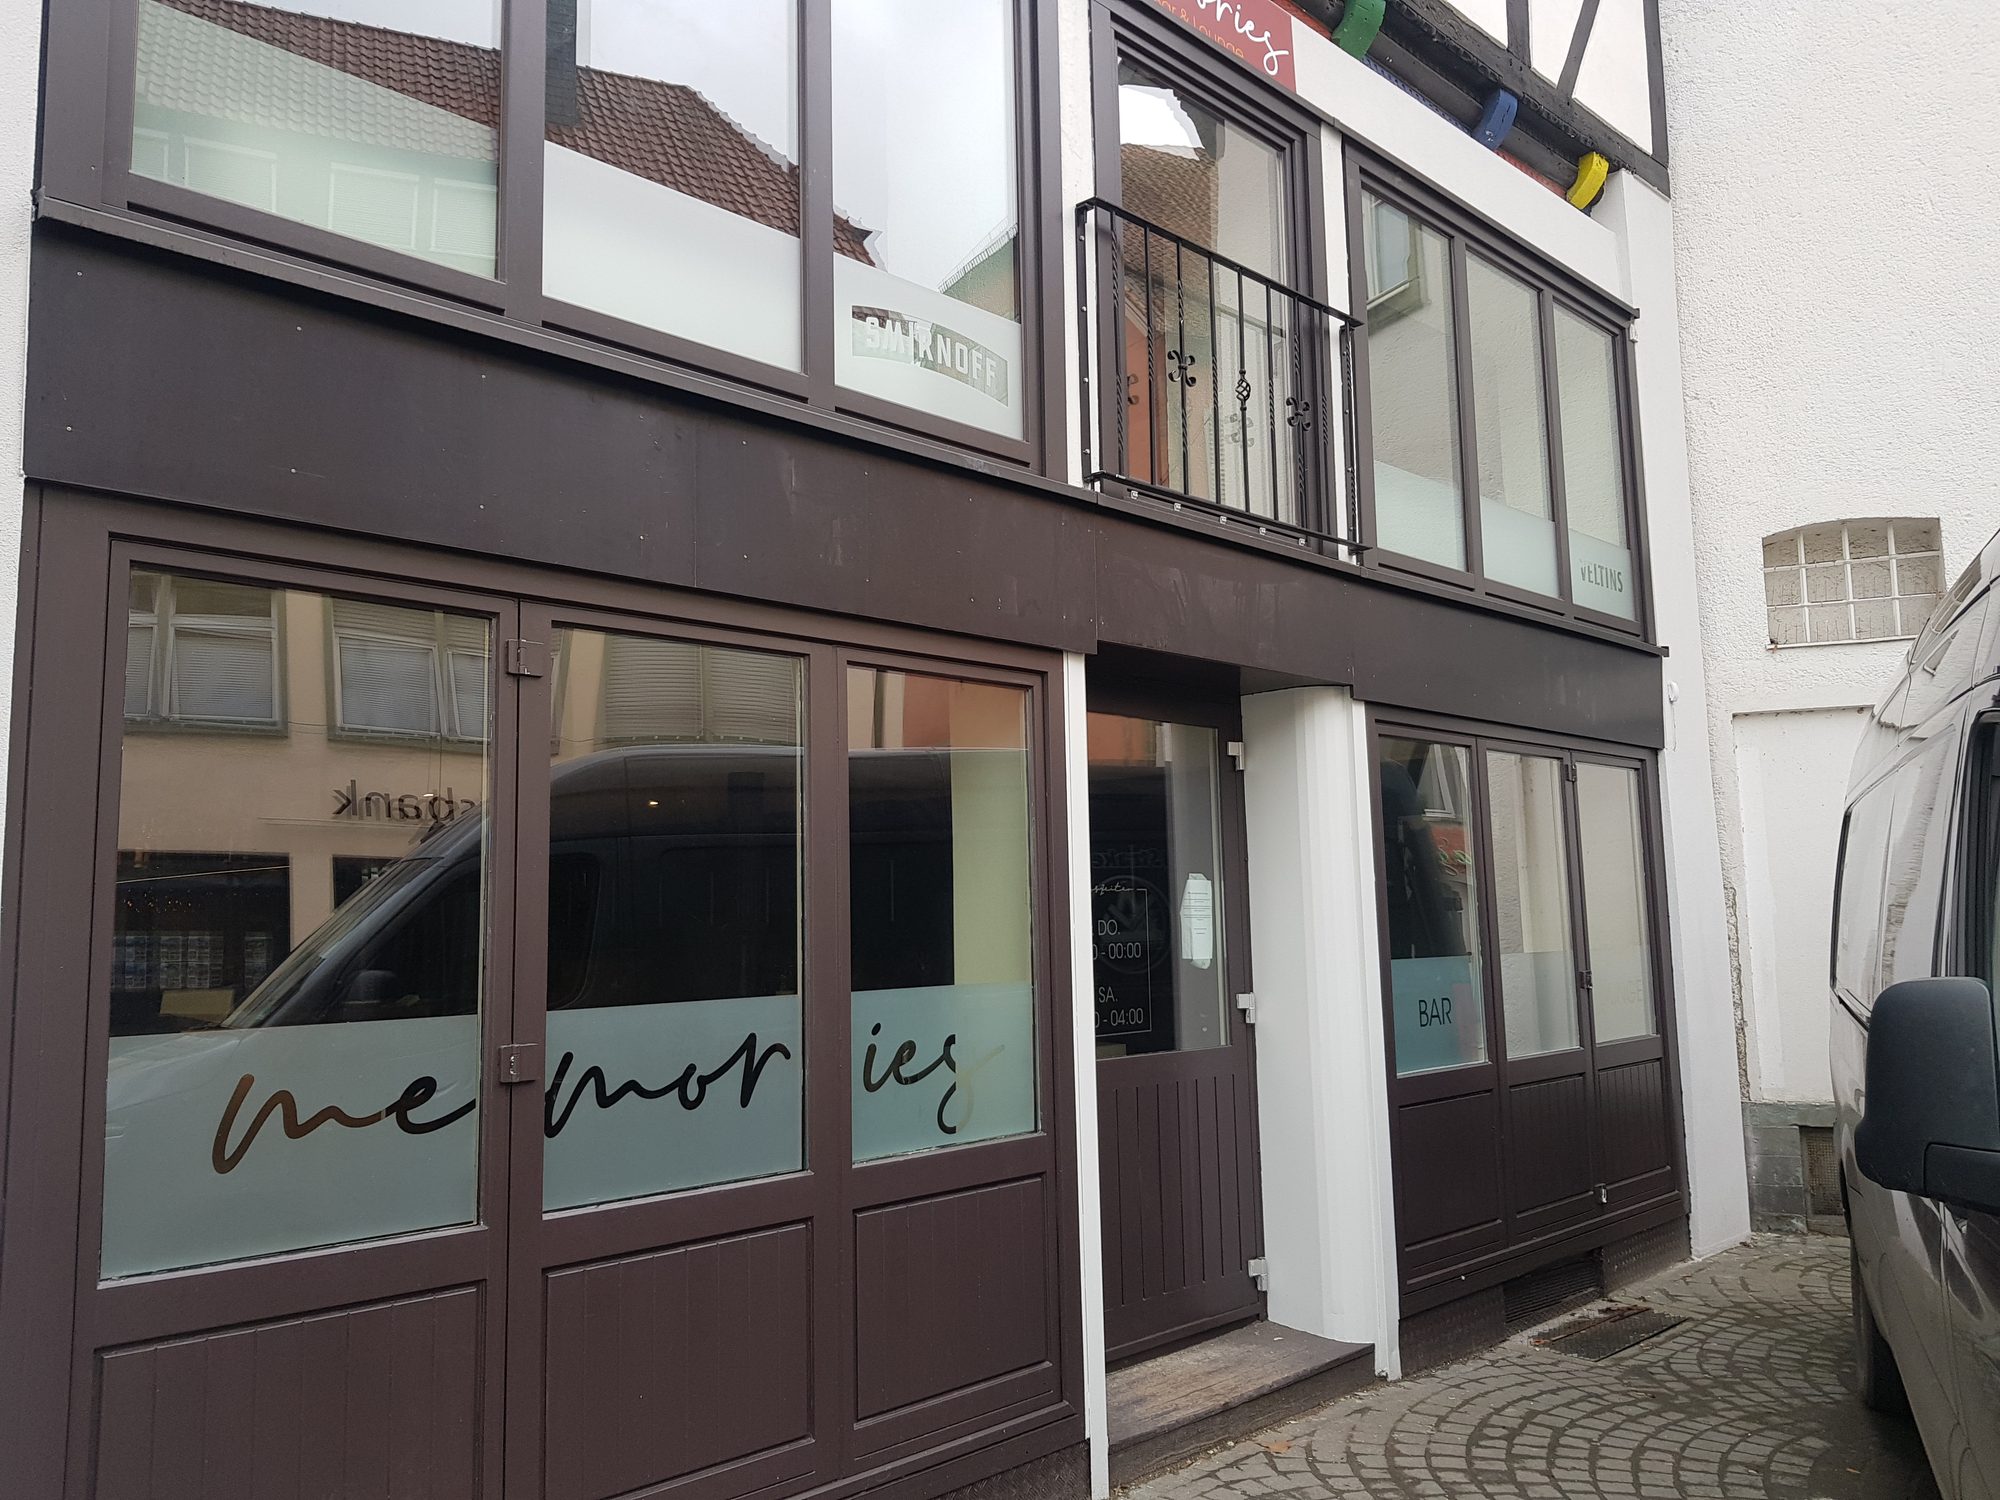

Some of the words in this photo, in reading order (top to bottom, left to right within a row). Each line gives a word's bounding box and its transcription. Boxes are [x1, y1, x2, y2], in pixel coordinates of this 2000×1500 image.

[865, 316, 997, 388] SMIRNOFF
[1580, 562, 1623, 593] VELTINS
[1097, 919, 1121, 936] DO.
[1108, 942, 1142, 960] 00:00
[1098, 985, 1118, 1003] SA.
[1110, 1007, 1144, 1026] 04:00
[1418, 997, 1452, 1028] BAR
